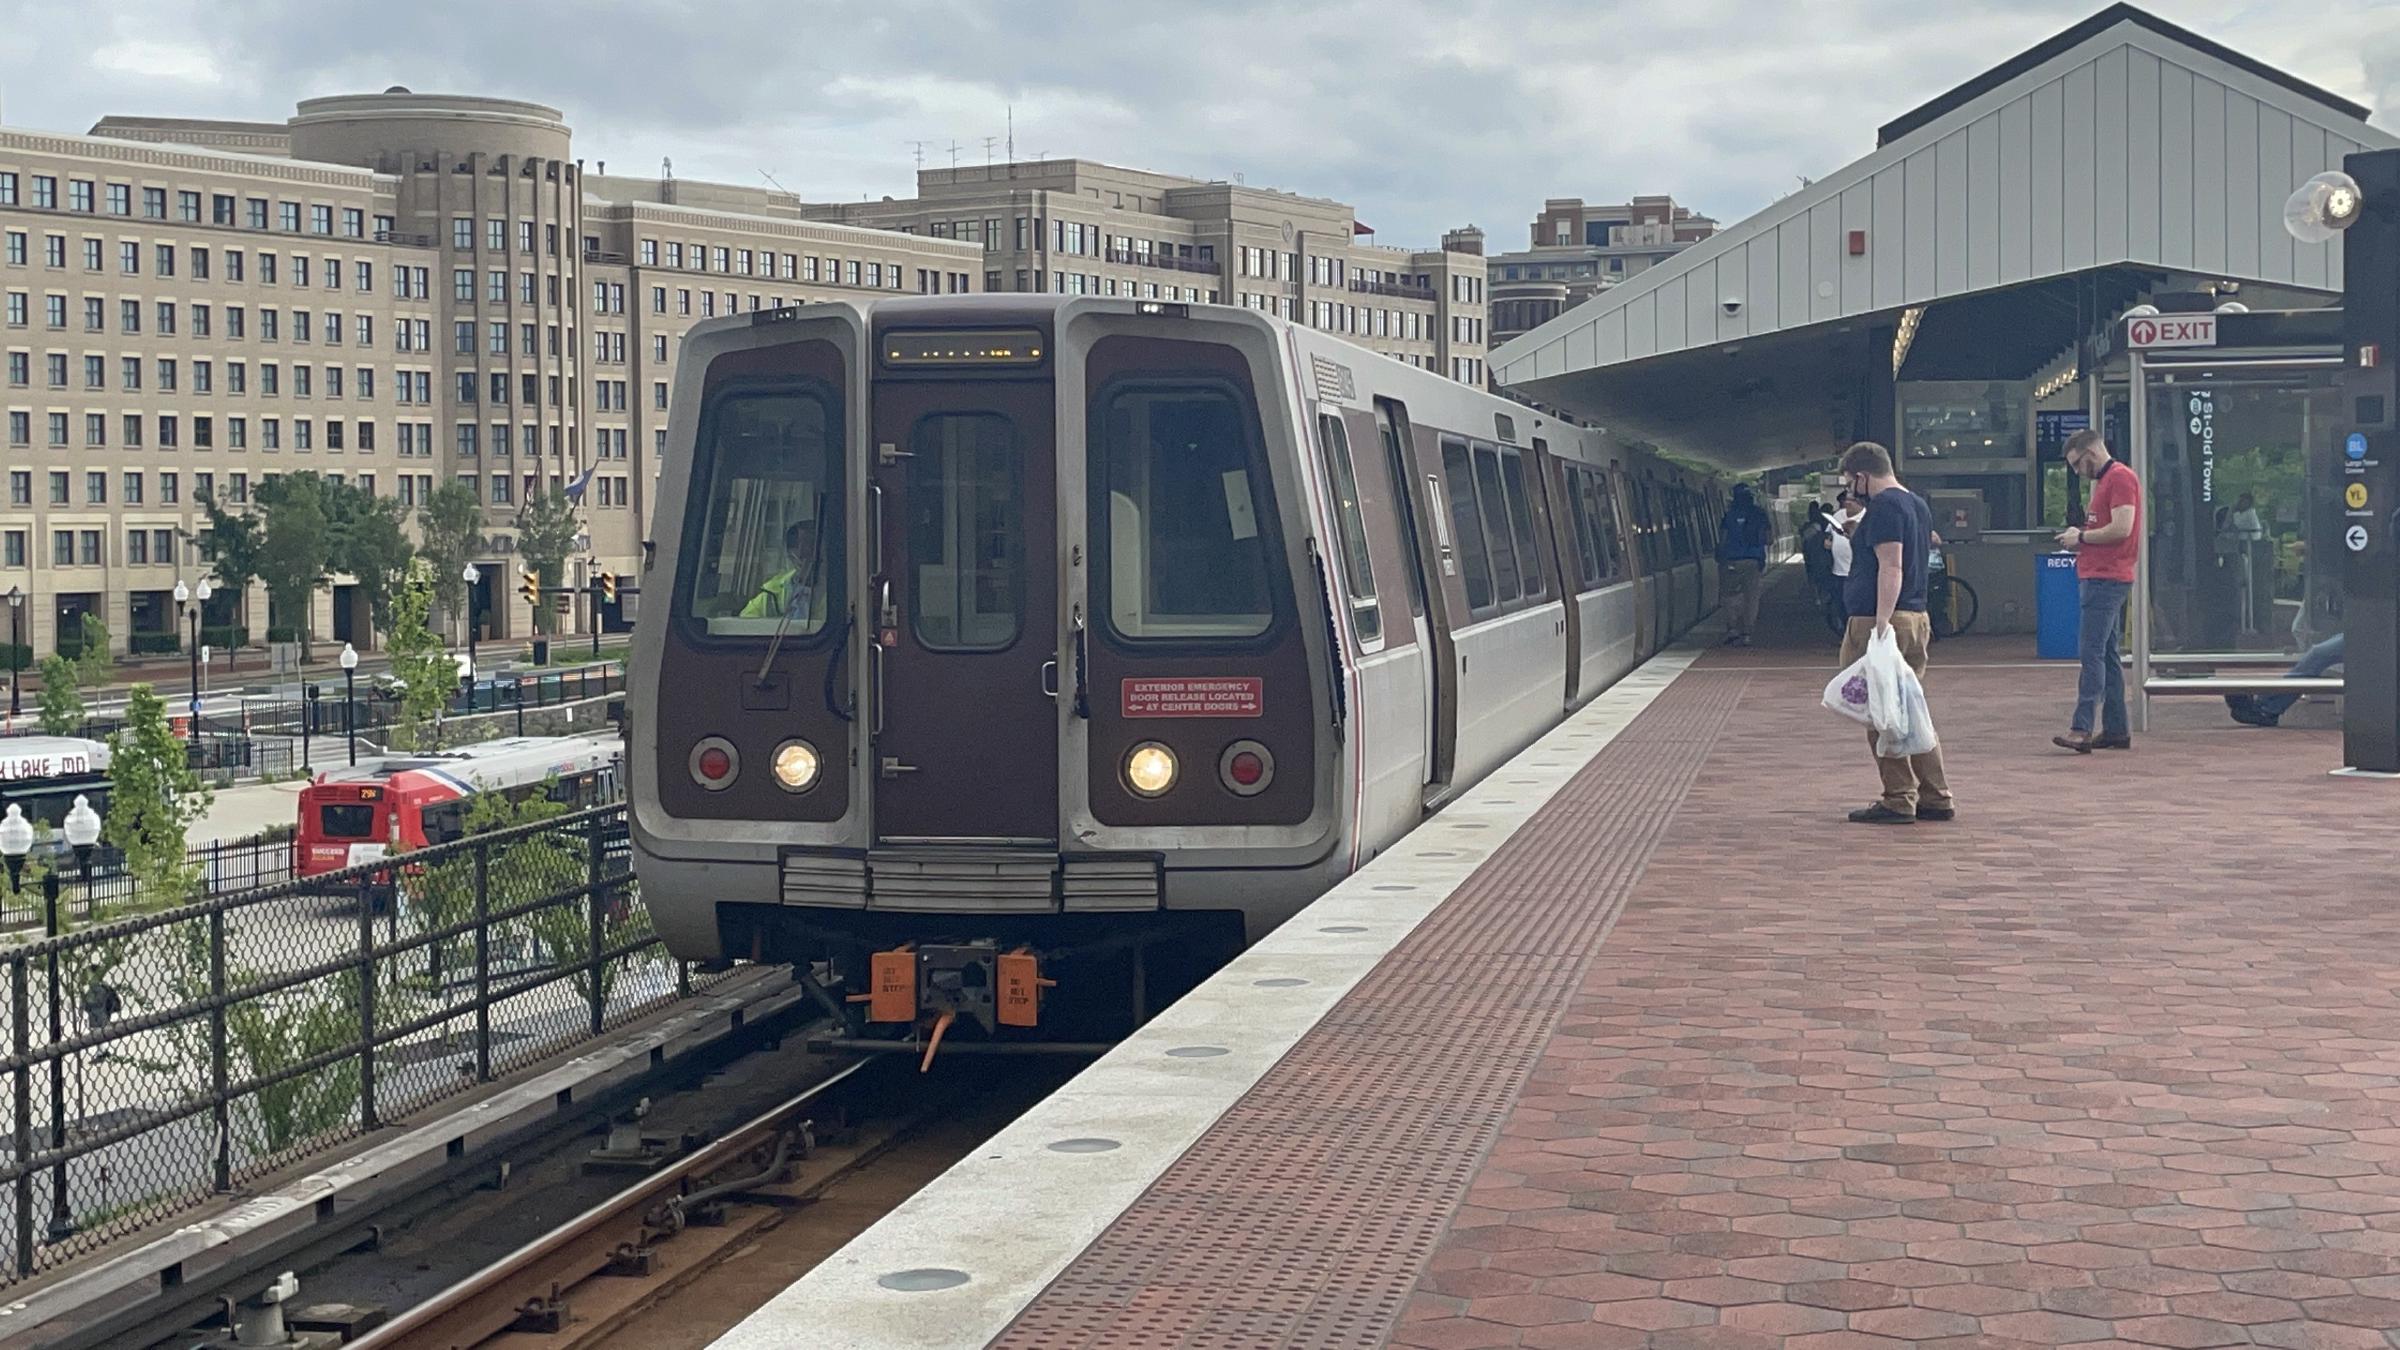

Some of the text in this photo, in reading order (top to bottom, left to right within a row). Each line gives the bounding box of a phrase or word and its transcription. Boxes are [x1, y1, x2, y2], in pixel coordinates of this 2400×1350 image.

[2160, 321, 2213, 340] EXIT
[2203, 458, 2213, 502] Town
[2349, 490, 2362, 501] YL
[1134, 682, 1250, 692] EXTERIOR EMERGENCY
[1129, 692, 1255, 702] DOOR RELEASE LOCATED
[1146, 702, 1239, 711] AT CENTER DOORS
